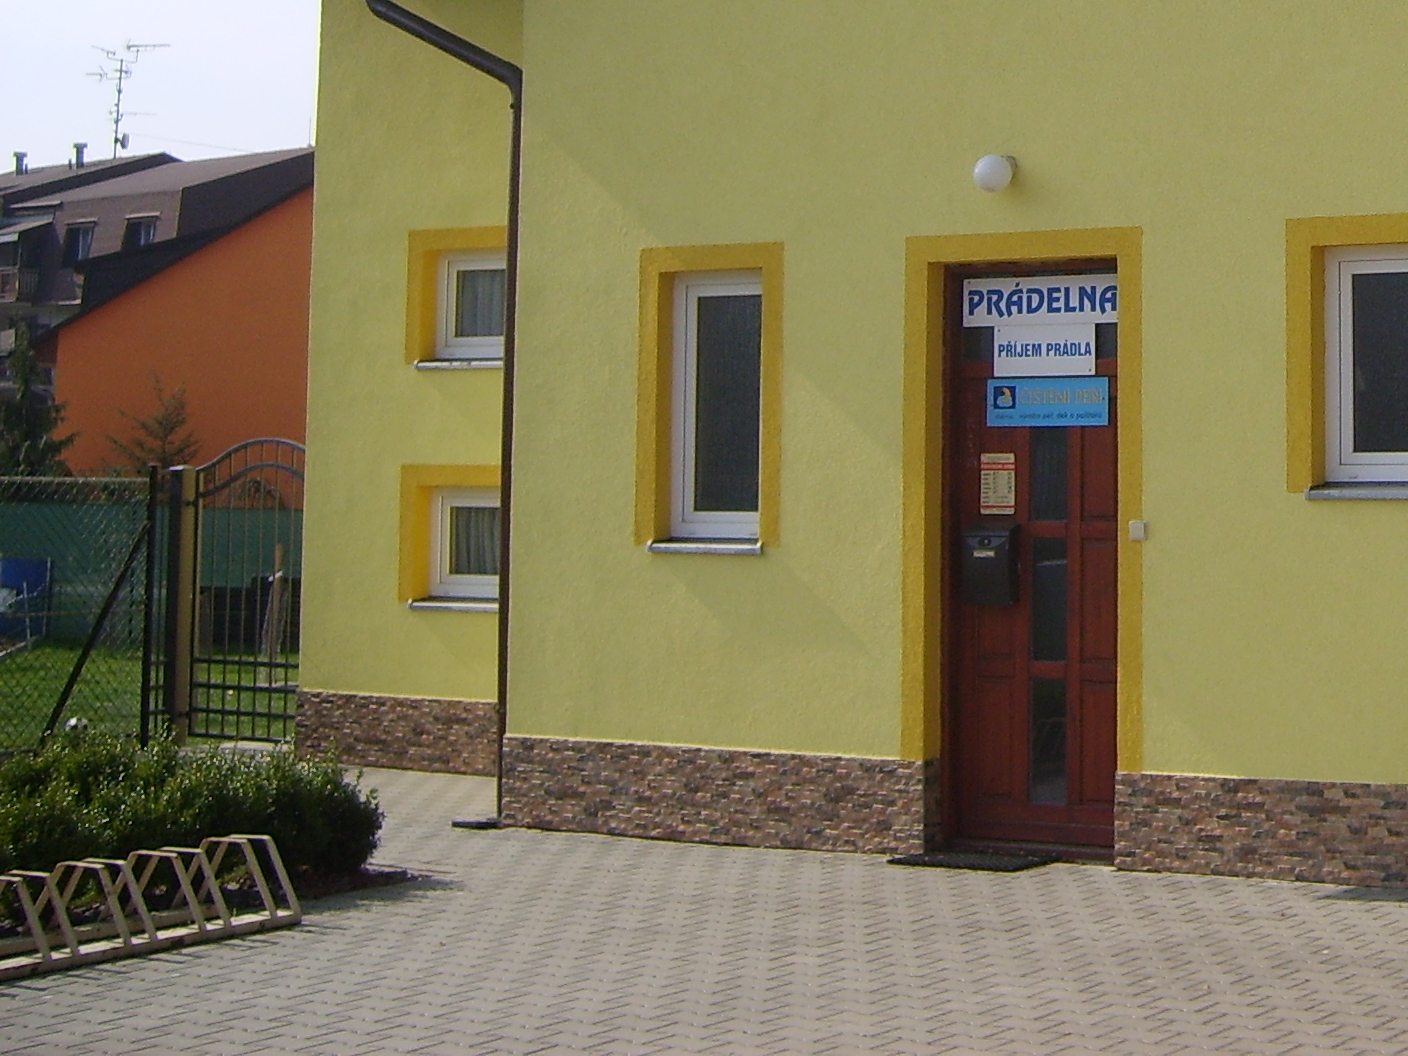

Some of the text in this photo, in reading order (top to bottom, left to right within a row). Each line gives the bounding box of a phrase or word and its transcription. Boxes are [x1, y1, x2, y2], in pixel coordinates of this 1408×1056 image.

[968, 282, 1117, 318] PRÁDELNA
[998, 339, 1092, 357] PŘÍJEM PRÁDLA
